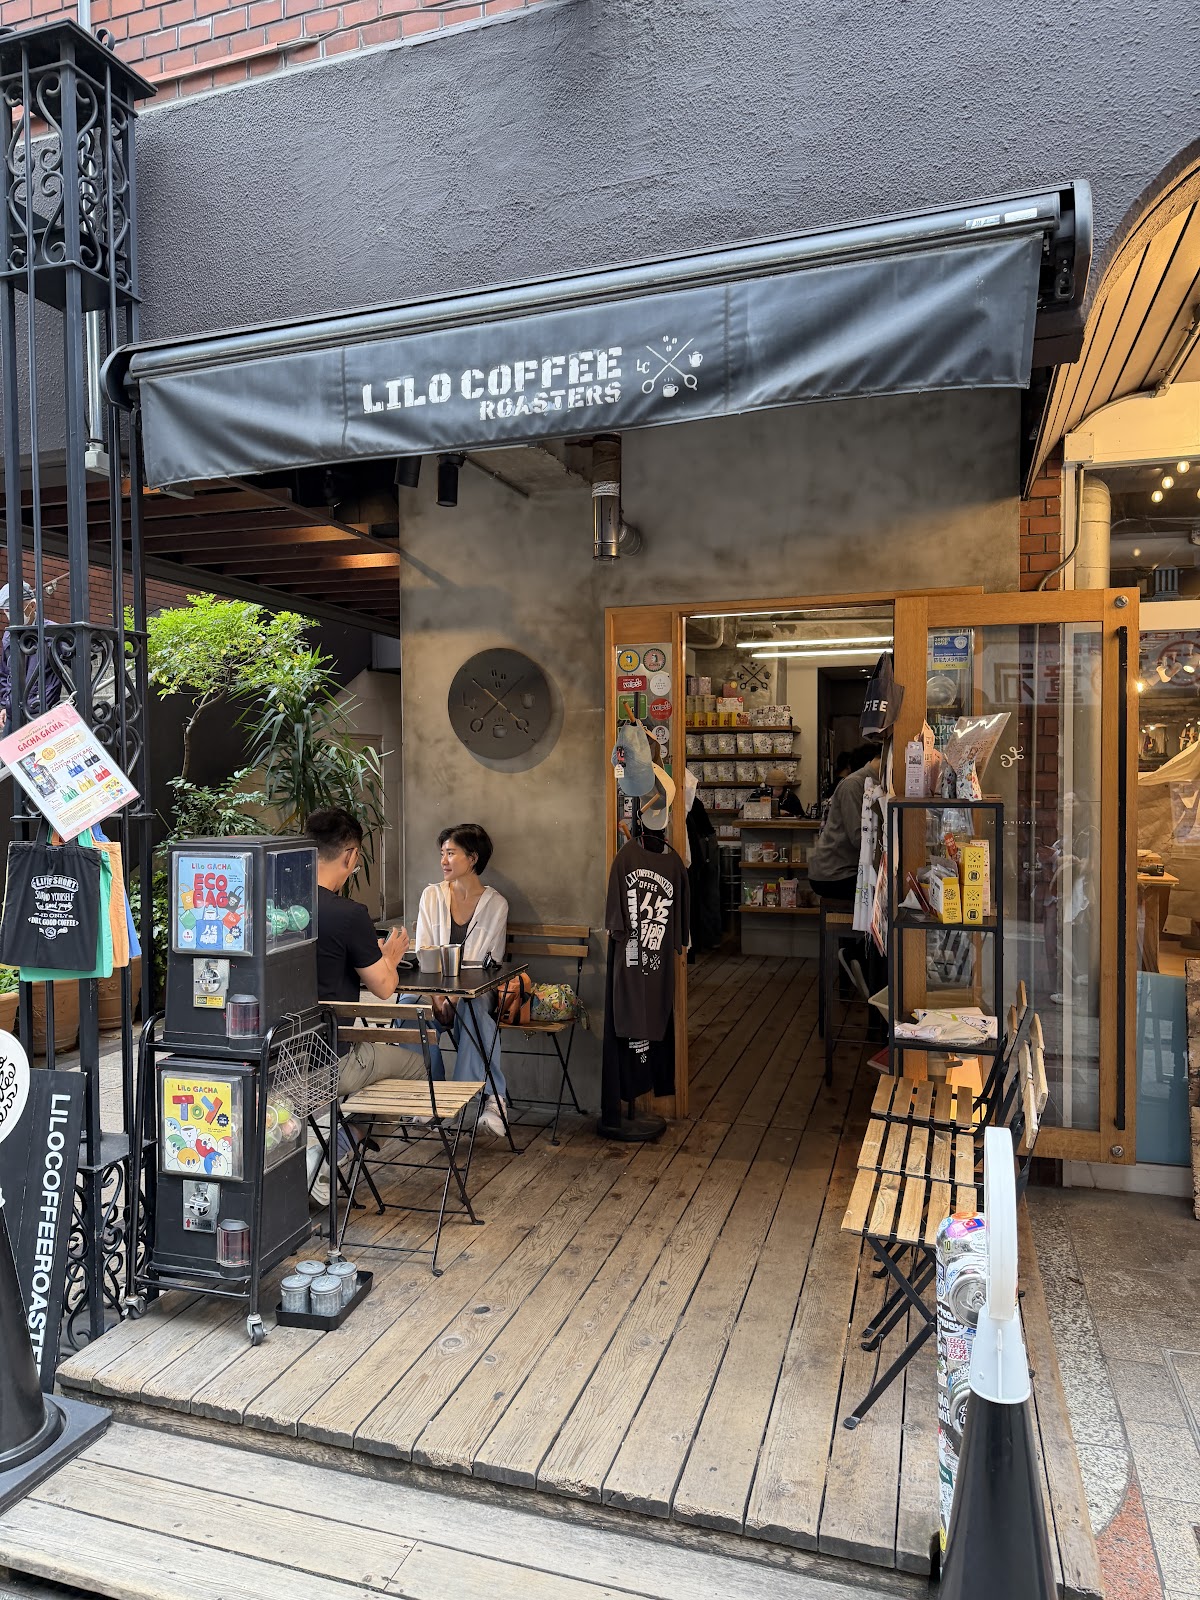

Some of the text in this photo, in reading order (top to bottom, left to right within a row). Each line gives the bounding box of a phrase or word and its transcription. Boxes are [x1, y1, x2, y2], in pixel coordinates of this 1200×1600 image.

[362, 346, 622, 414] LILO COFFEE
[479, 381, 622, 421] ROASTERS
[17, 734, 42, 752] GACHA
[40, 721, 64, 737] GACHA
[207, 863, 232, 871] GACHA
[193, 872, 228, 892] ECO
[192, 889, 229, 909] BAG
[193, 1085, 218, 1094] GACHA
[28, 1094, 71, 1378] LILOCOFFEEROASTE
